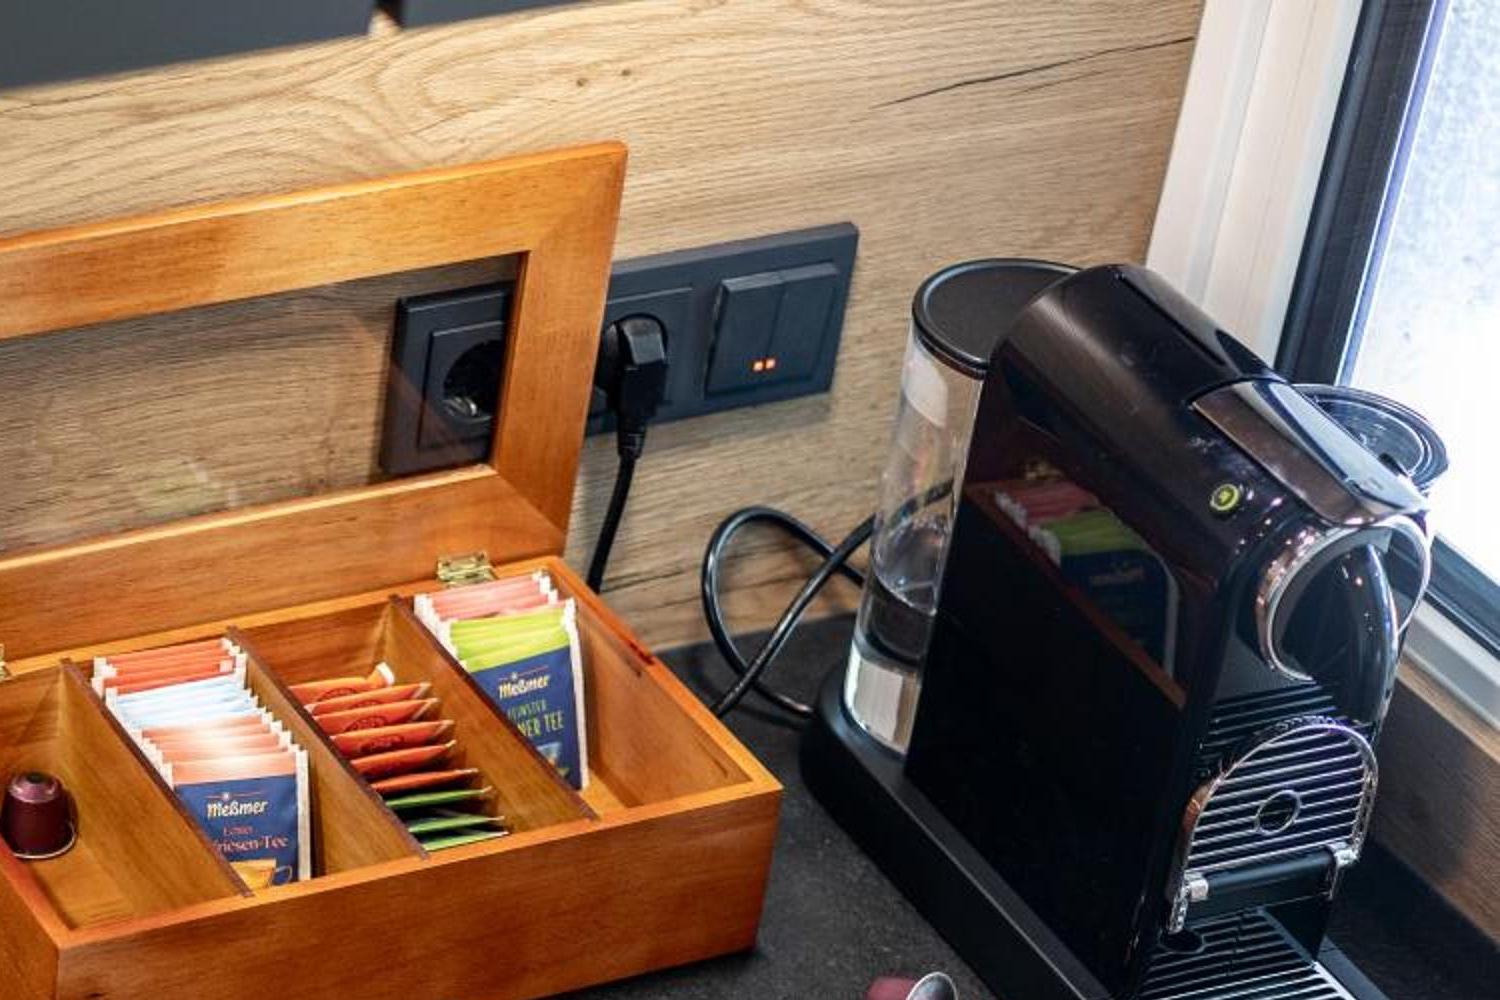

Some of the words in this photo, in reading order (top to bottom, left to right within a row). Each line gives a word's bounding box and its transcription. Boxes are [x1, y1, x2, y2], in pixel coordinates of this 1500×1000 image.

[498, 675, 550, 699] Meßmer
[543, 710, 564, 733] TEE
[206, 800, 268, 821] Meßmer
